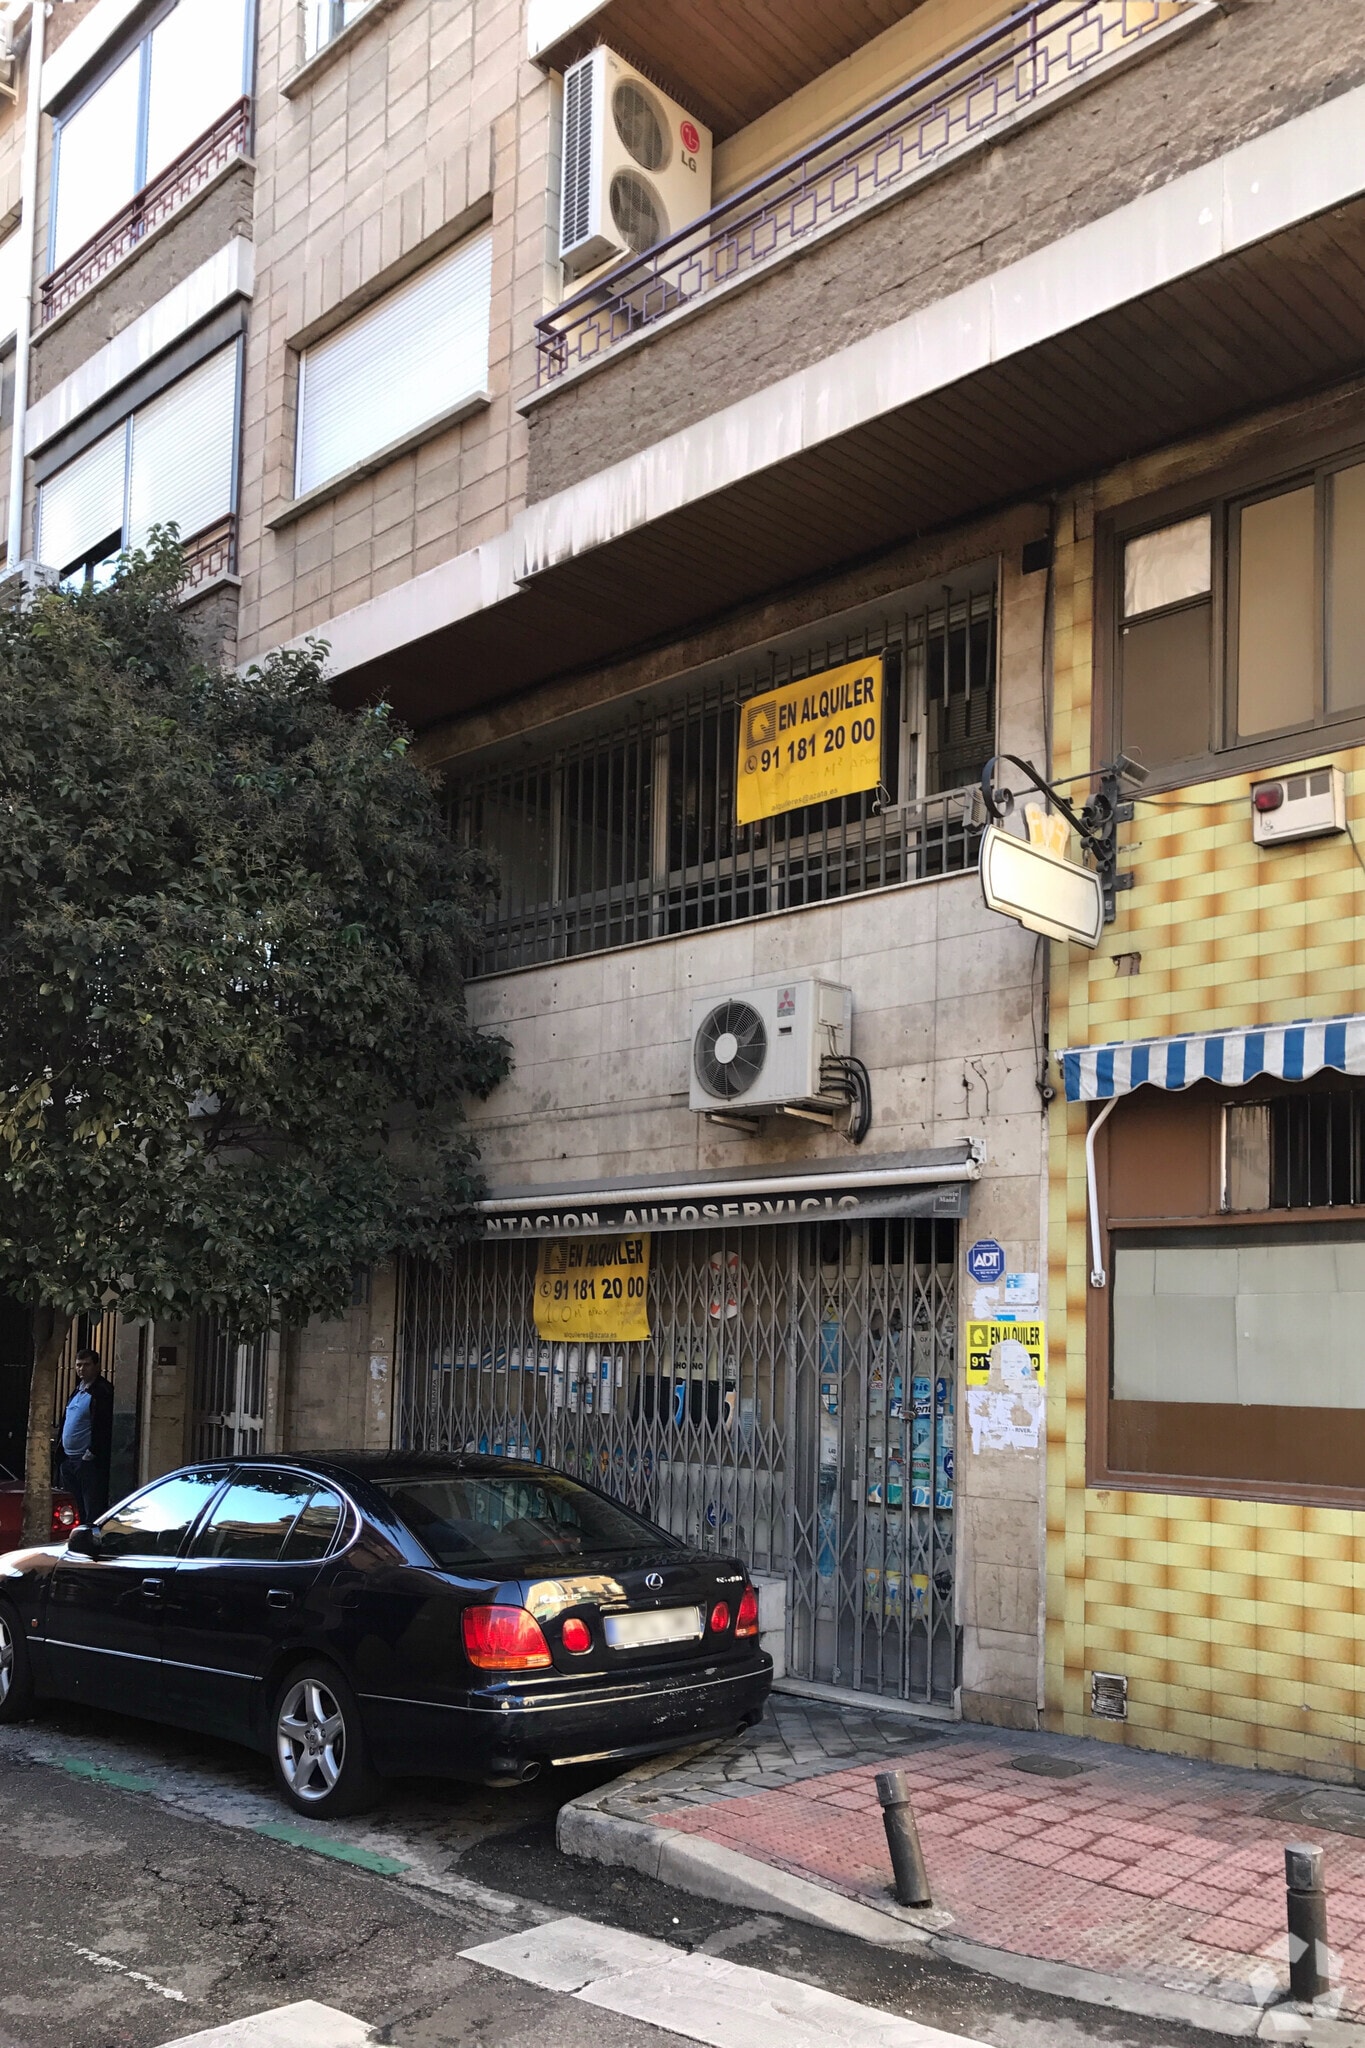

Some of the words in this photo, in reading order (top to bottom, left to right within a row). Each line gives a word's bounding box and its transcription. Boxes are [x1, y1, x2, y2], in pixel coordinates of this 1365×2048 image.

[681, 150, 697, 173] LG
[778, 700, 797, 732] EN
[800, 676, 875, 724] ALQUILER
[761, 746, 780, 772] 91
[787, 734, 816, 764] 181
[824, 725, 845, 754] 20
[851, 717, 876, 745] 00
[568, 1244, 583, 1268] EN
[585, 1239, 644, 1268] ALQUILER
[973, 1252, 1000, 1267] ADT
[554, 1279, 569, 1300] 91
[573, 1279, 596, 1300] 181
[601, 1277, 623, 1300] 20
[627, 1276, 644, 1298] 00
[990, 1326, 1001, 1346] EN
[674, 1361, 704, 1370] HONO
[971, 1356, 985, 1367] 91
[898, 1381, 930, 1392] Obit
